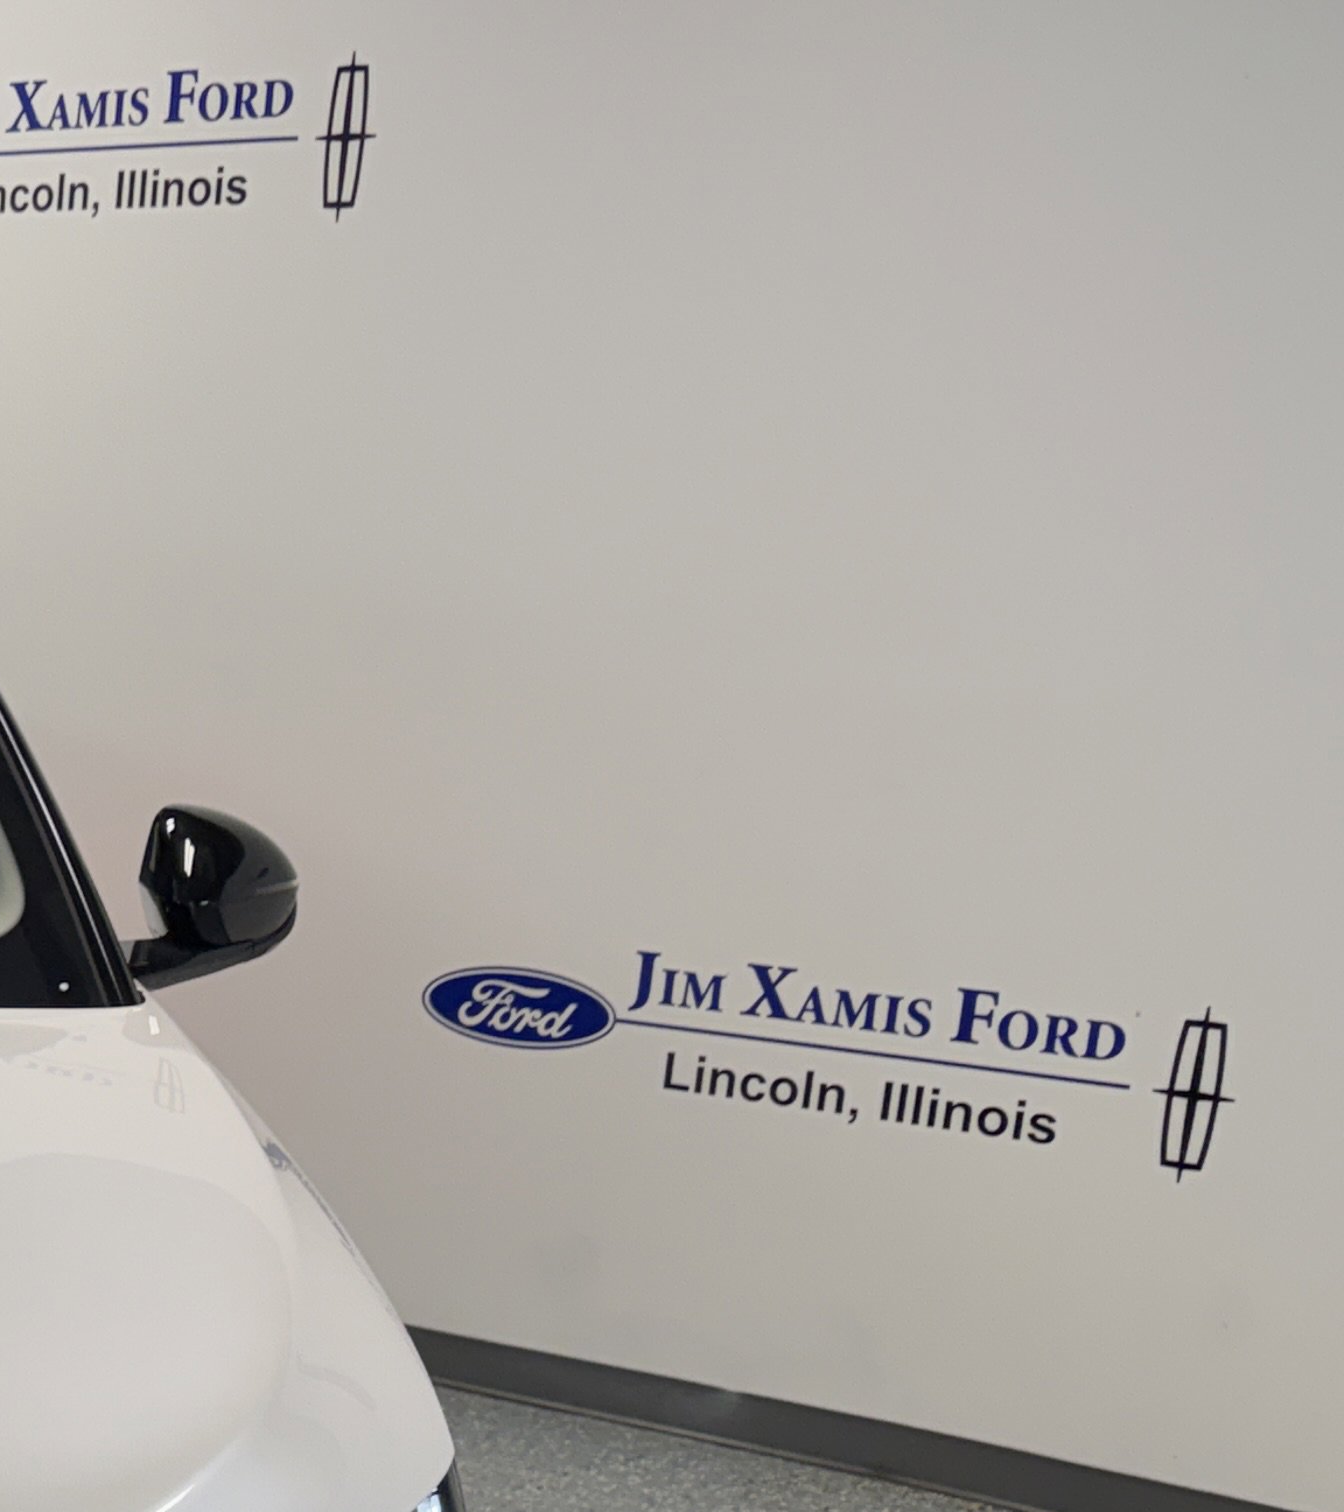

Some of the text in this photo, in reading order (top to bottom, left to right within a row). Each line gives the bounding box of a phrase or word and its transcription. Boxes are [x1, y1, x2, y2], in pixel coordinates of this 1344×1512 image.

[115, 166, 248, 209] Illinois
[456, 978, 575, 1039] Ford
[662, 1052, 1058, 1146] Lincoln, Illinois
